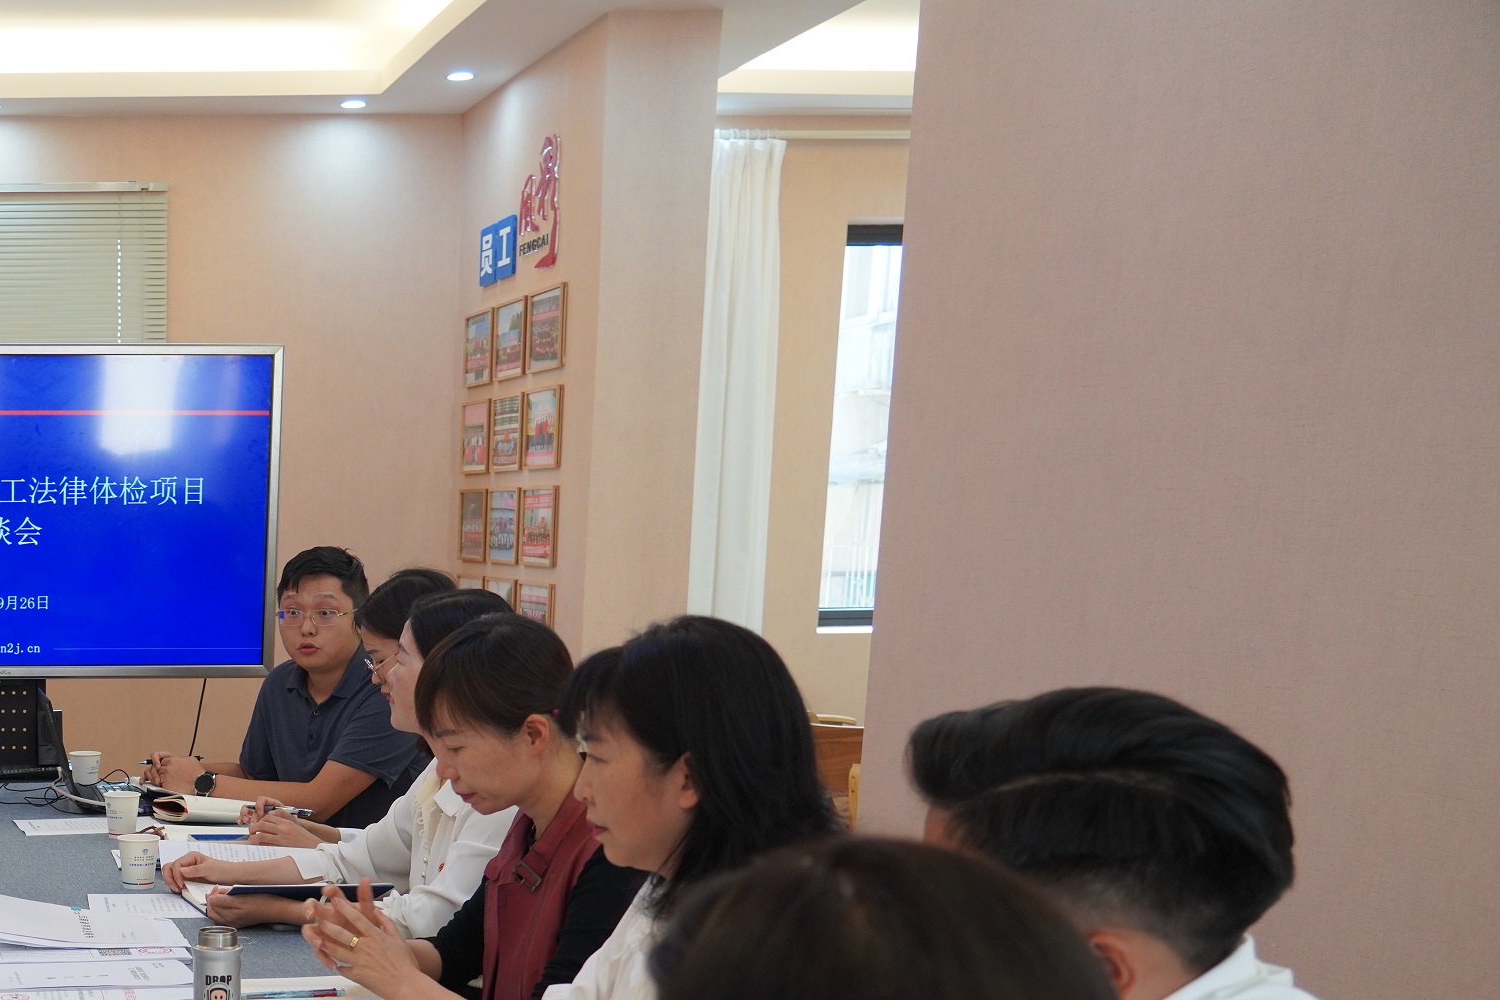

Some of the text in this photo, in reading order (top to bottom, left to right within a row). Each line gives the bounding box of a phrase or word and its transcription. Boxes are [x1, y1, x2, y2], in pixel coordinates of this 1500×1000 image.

[480, 225, 512, 278] 员工
[518, 233, 550, 257] FENGCAI
[205, 974, 233, 986] DROP
